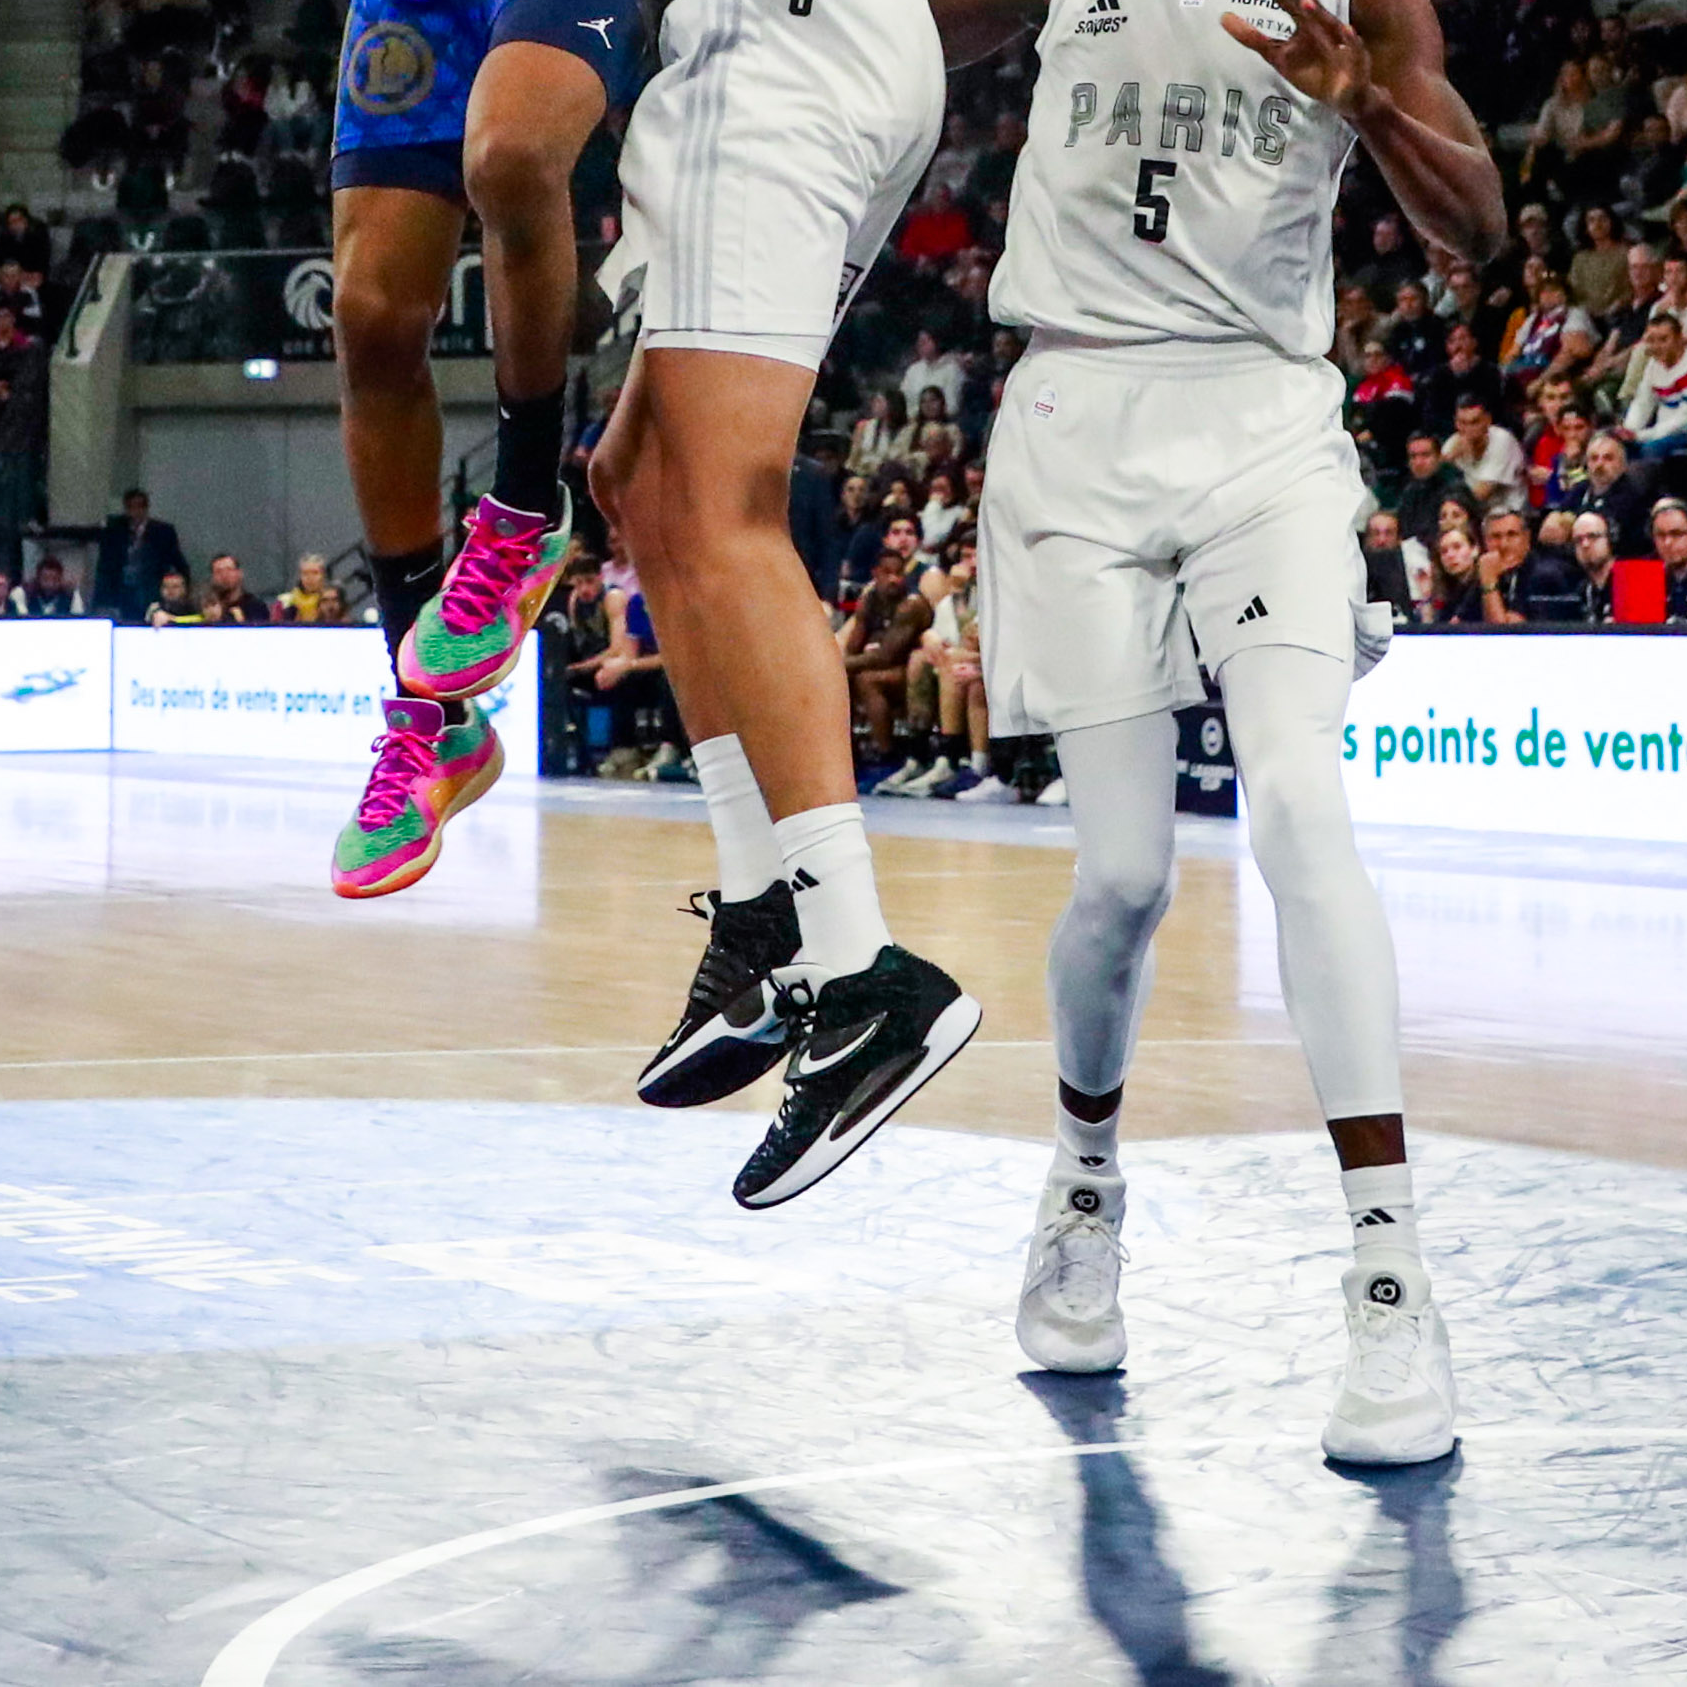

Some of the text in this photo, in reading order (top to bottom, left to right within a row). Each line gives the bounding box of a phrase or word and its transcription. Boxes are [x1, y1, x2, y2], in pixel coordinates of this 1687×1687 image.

[1065, 81, 1292, 166] PARIS
[1133, 159, 1177, 245] 5
[1375, 708, 1498, 778] points
[1515, 707, 1567, 768] de
